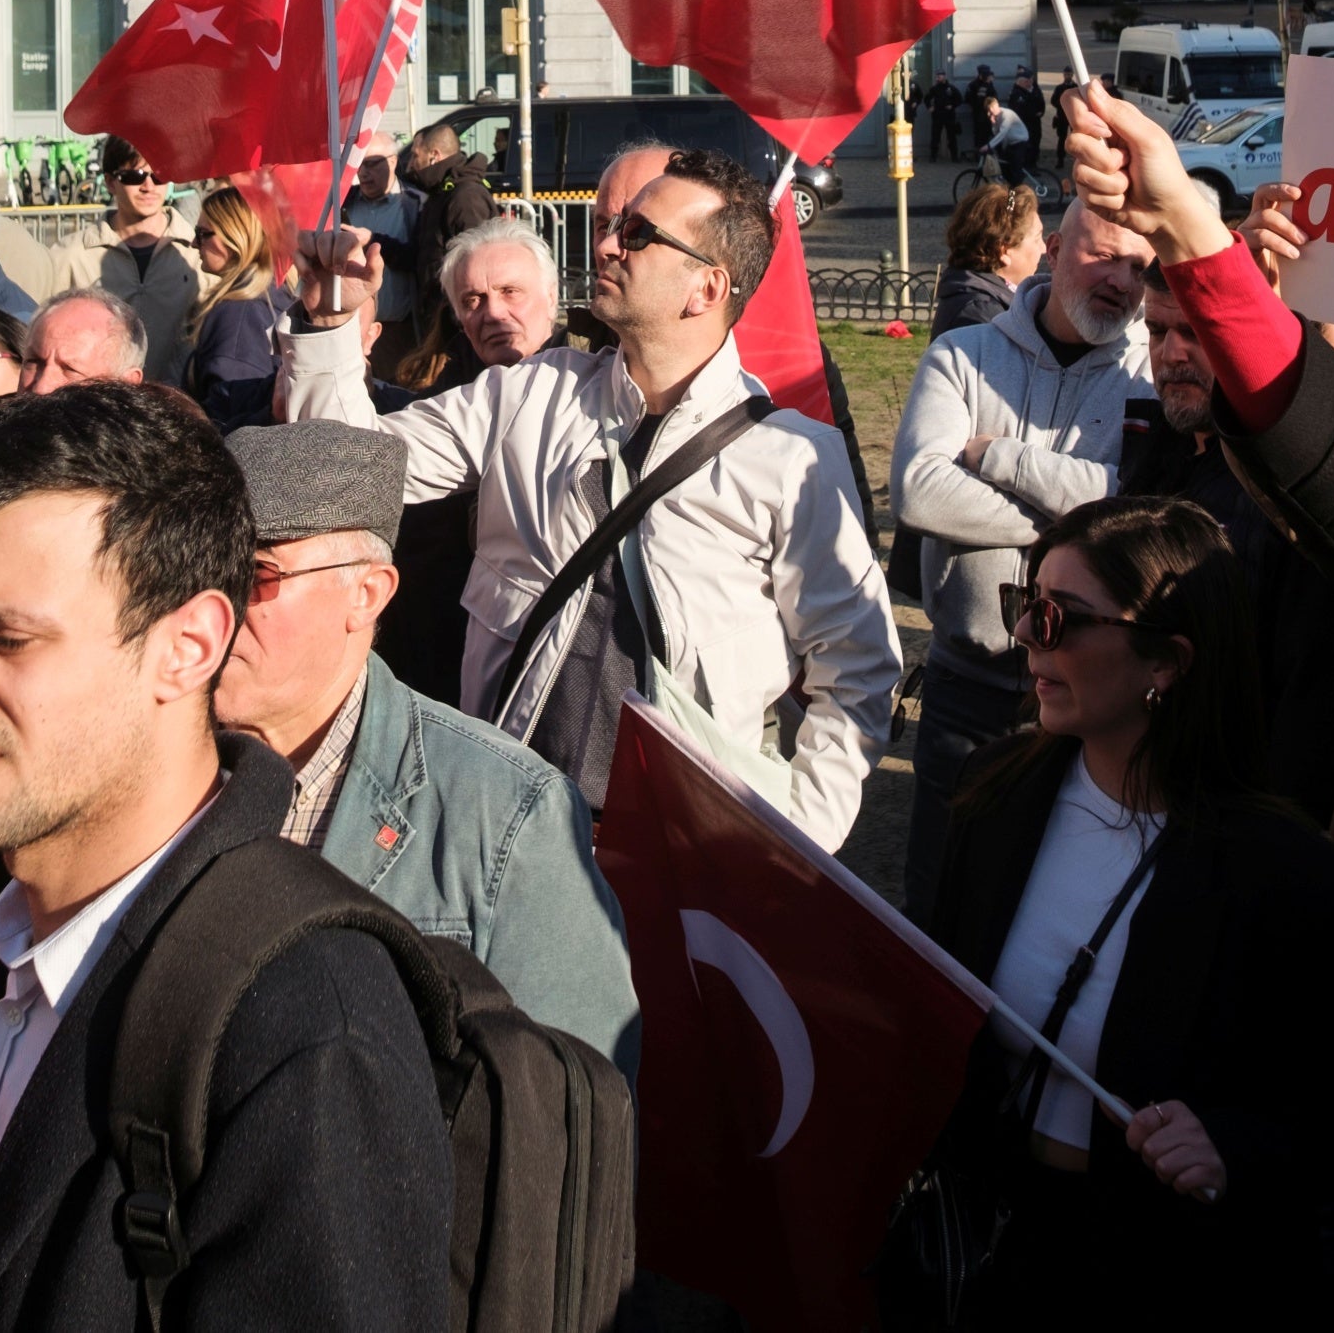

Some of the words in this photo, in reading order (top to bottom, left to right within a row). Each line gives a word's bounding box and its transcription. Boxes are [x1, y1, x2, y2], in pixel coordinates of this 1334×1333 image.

[22, 52, 49, 61] Station
[22, 61, 48, 72] Europe
[1259, 151, 1283, 163] Poli
